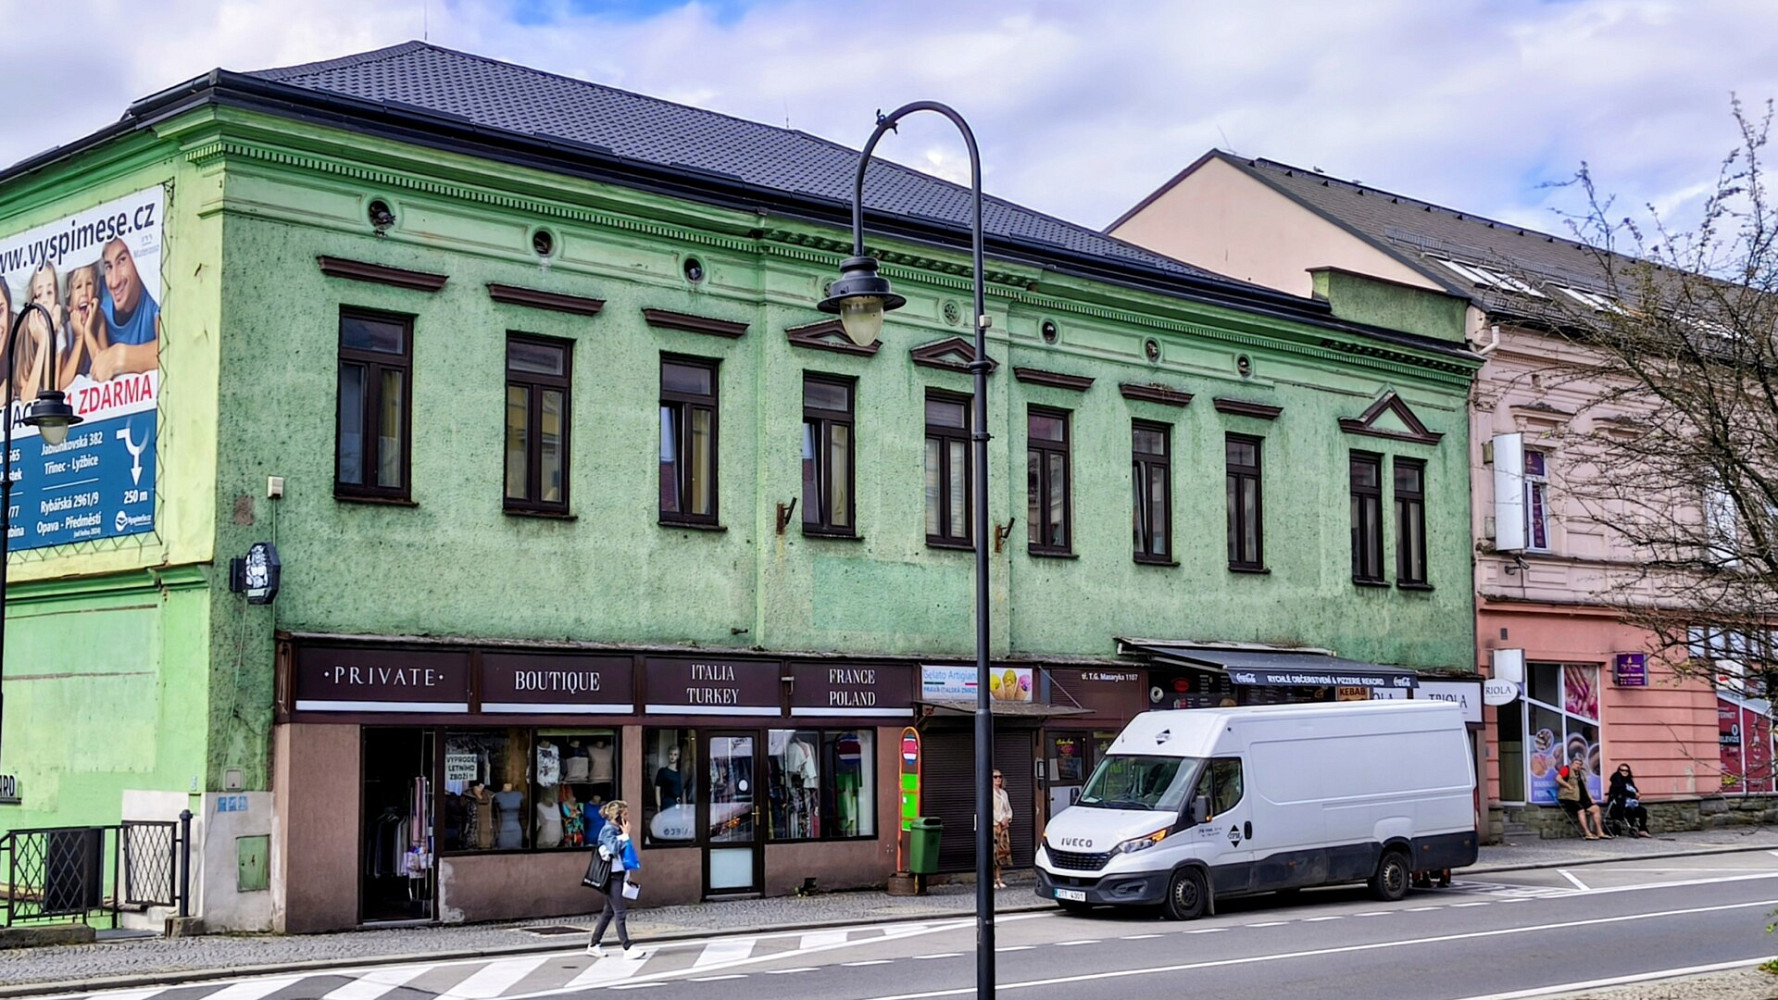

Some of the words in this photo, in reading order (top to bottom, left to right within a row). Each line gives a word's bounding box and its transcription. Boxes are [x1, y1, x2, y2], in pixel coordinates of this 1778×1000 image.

[78, 374, 152, 415] ZDARMA
[89, 431, 103, 446] 382
[44, 461, 66, 475] Třinec
[72, 453, 99, 473] Lyžbice
[124, 489, 139, 504] 250
[140, 490, 148, 502] m
[40, 495, 72, 517] Rybářská
[36, 520, 60, 536] Opava
[65, 511, 102, 530] Předměstí
[334, 666, 436, 686] PRIVATE
[691, 664, 735, 681] ITALIA
[829, 668, 876, 685] FRANCE
[1100, 672, 1125, 683] Masaryka
[1267, 674, 1292, 684] RYCHLÉ
[1292, 674, 1331, 685] OBČERSTVENÍ
[1337, 677, 1361, 686] PIZZERIE
[1361, 678, 1385, 687] REKORD
[515, 670, 600, 694] BOUTIQUE
[686, 687, 740, 704] TURKEY
[829, 690, 876, 706] POLAND
[1339, 687, 1366, 697] KEBAB
[1485, 686, 1512, 695] RIOLA
[448, 764, 475, 772] LETNÍHO
[1061, 837, 1093, 848] IVECO
